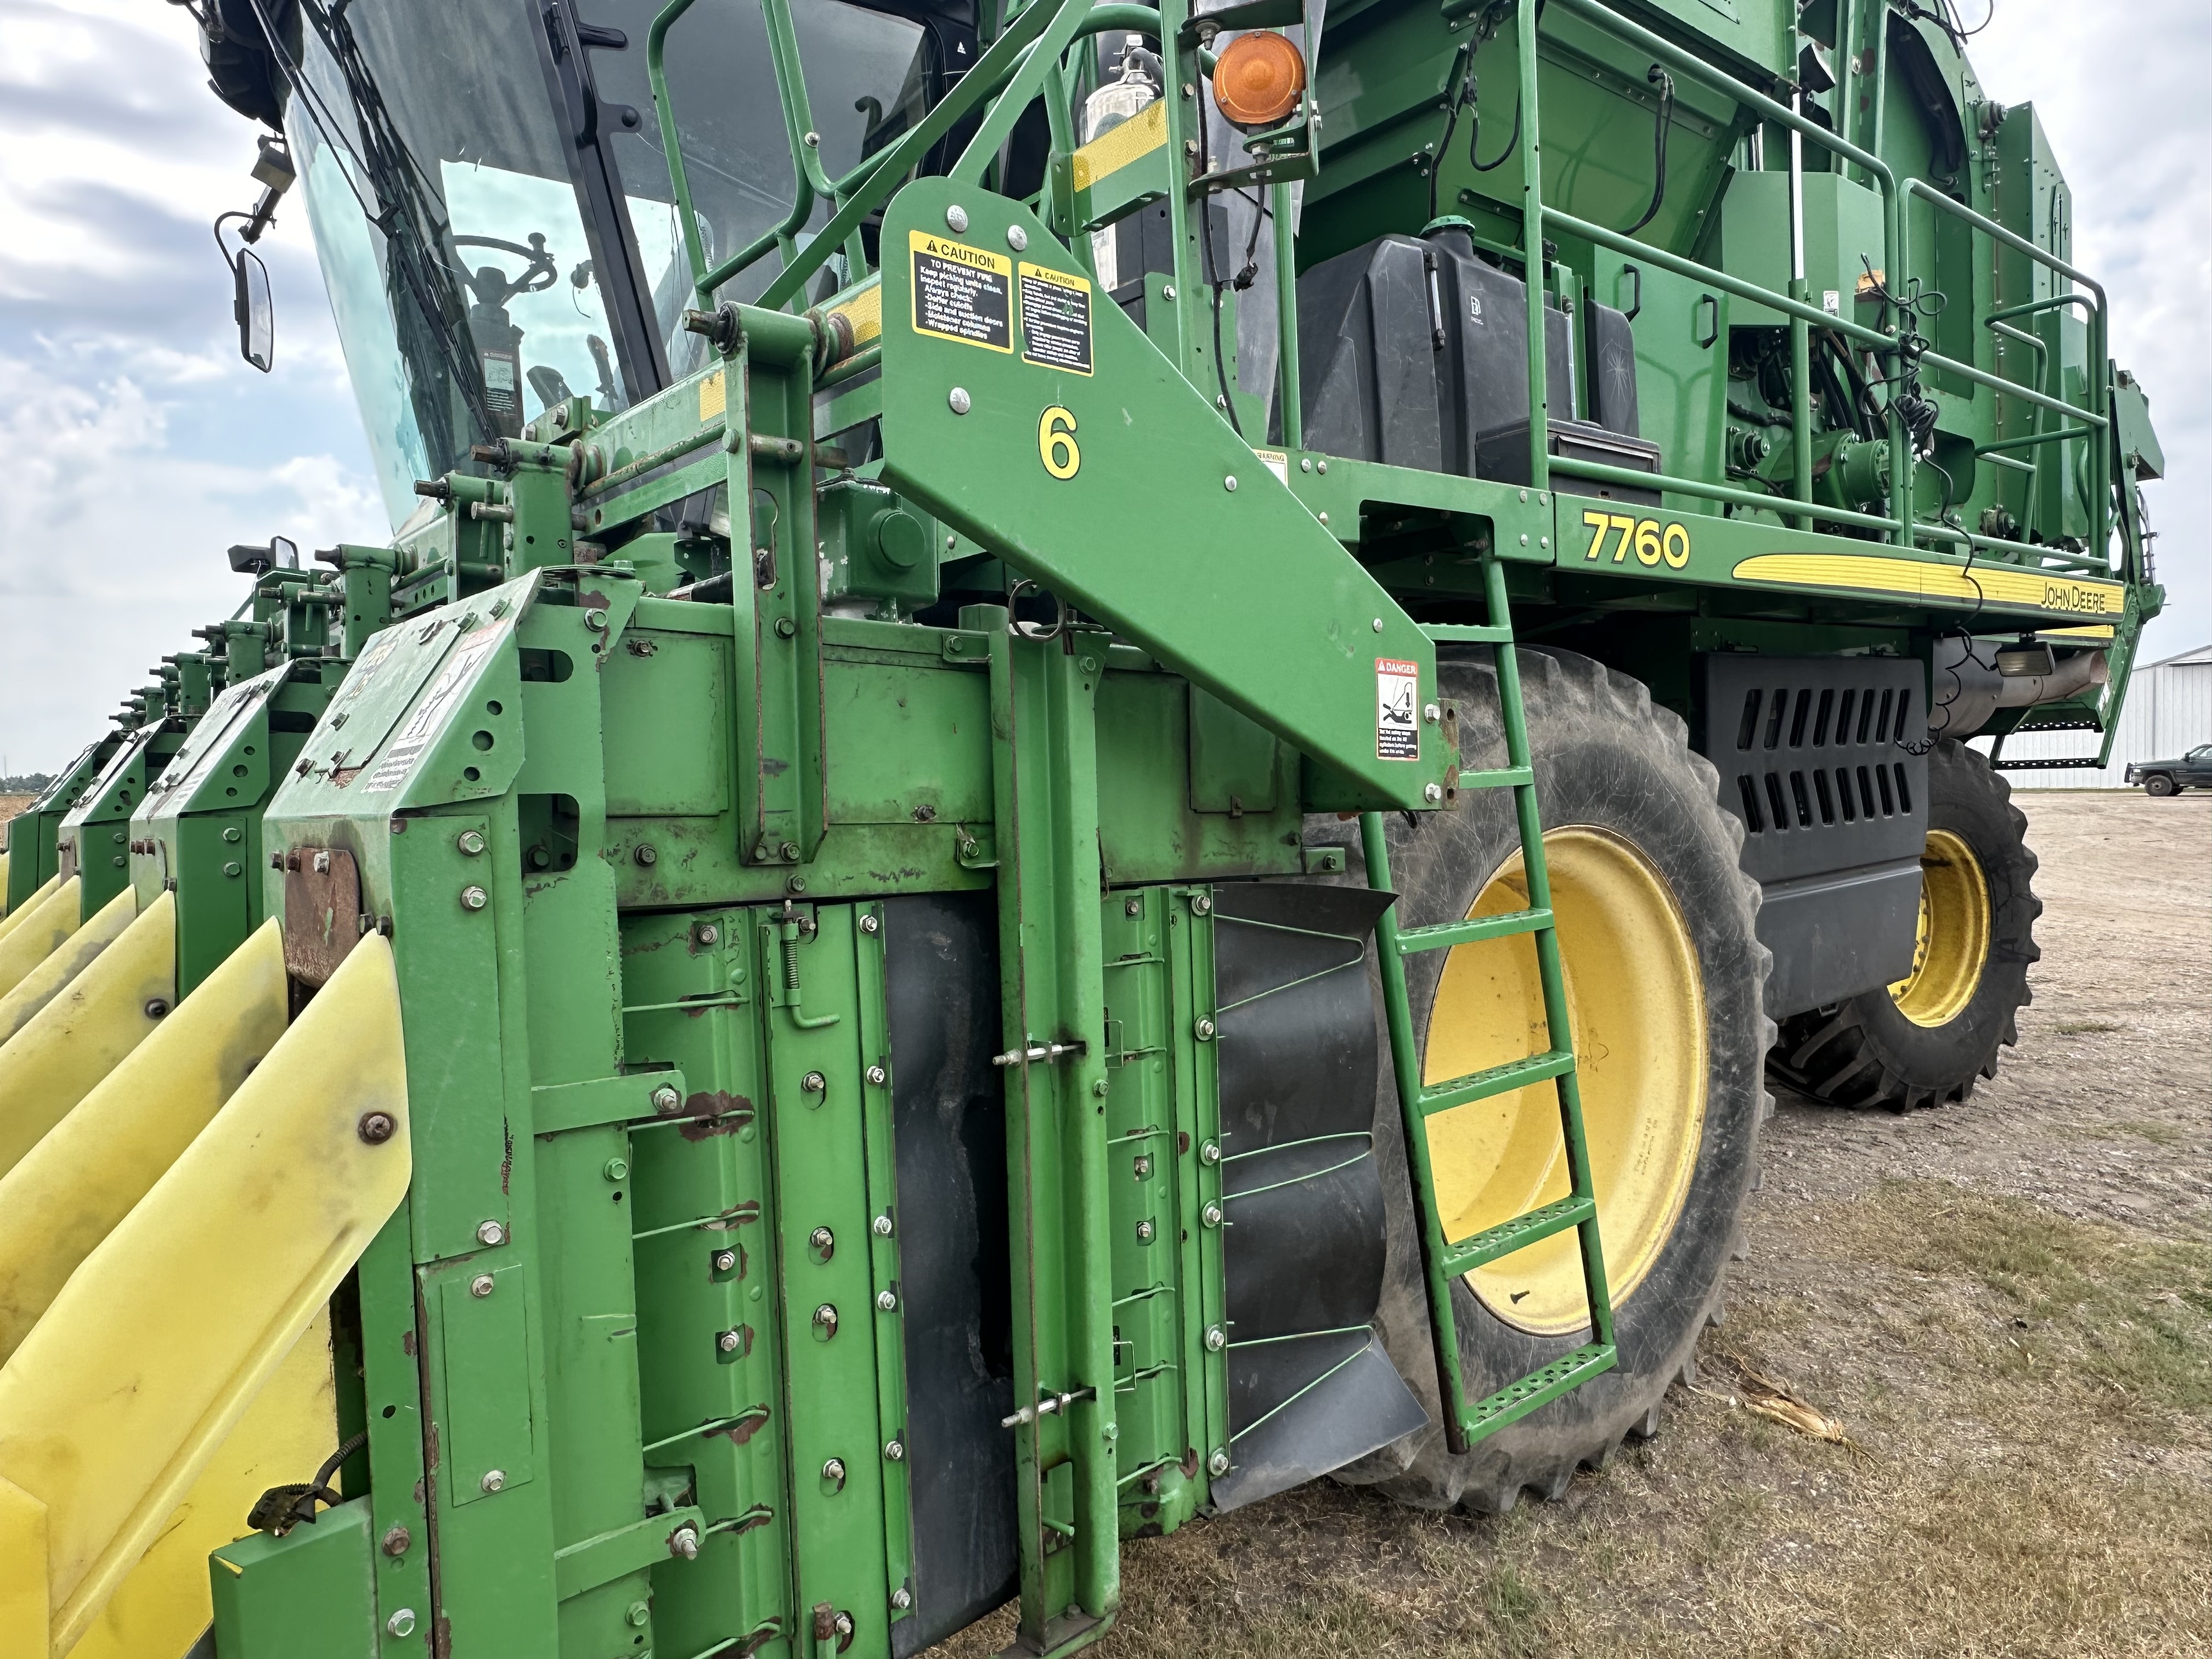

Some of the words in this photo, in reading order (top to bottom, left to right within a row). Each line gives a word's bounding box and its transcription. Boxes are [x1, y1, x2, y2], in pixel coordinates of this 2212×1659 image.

[941, 245, 995, 269] CAUTION
[921, 266, 938, 279] Keep
[931, 259, 941, 268] TO
[943, 262, 976, 279] PREVENT
[1045, 272, 1075, 286] CAUTION
[1038, 405, 1081, 481] 6
[1583, 509, 1690, 570] 7760
[2041, 582, 2070, 607] JOHN
[2072, 586, 2105, 611] DEERE
[1386, 662, 1417, 674] DANGER
